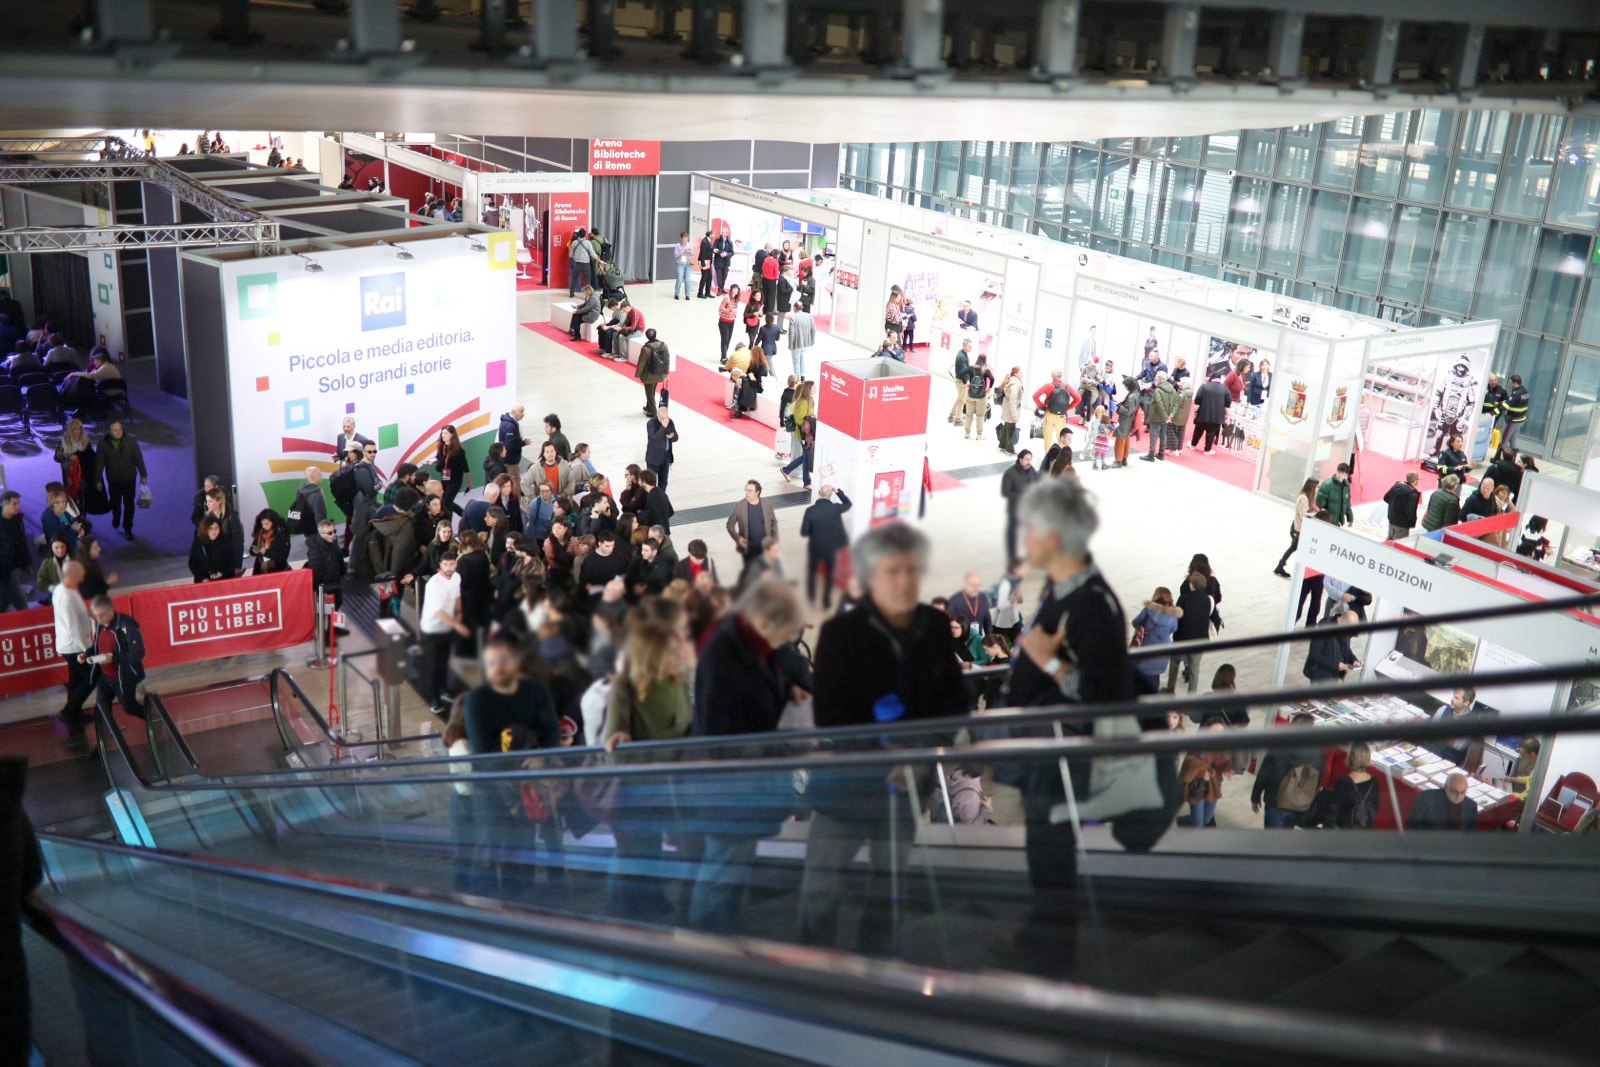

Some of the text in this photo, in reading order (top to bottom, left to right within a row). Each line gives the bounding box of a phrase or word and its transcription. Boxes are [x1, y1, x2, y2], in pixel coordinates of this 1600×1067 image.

[593, 138, 622, 147] Arena
[593, 150, 646, 159] Biblioteche
[593, 161, 631, 170] di Roma
[364, 286, 403, 316] Rai
[289, 328, 475, 372] Piccola e media editoria.
[318, 356, 452, 394] Solo grandi storie
[1329, 543, 1433, 593] PIANO B EDIZIONI
[178, 599, 261, 622] PIÙ LIBRI
[179, 611, 273, 636] PIÙ LIBERI
